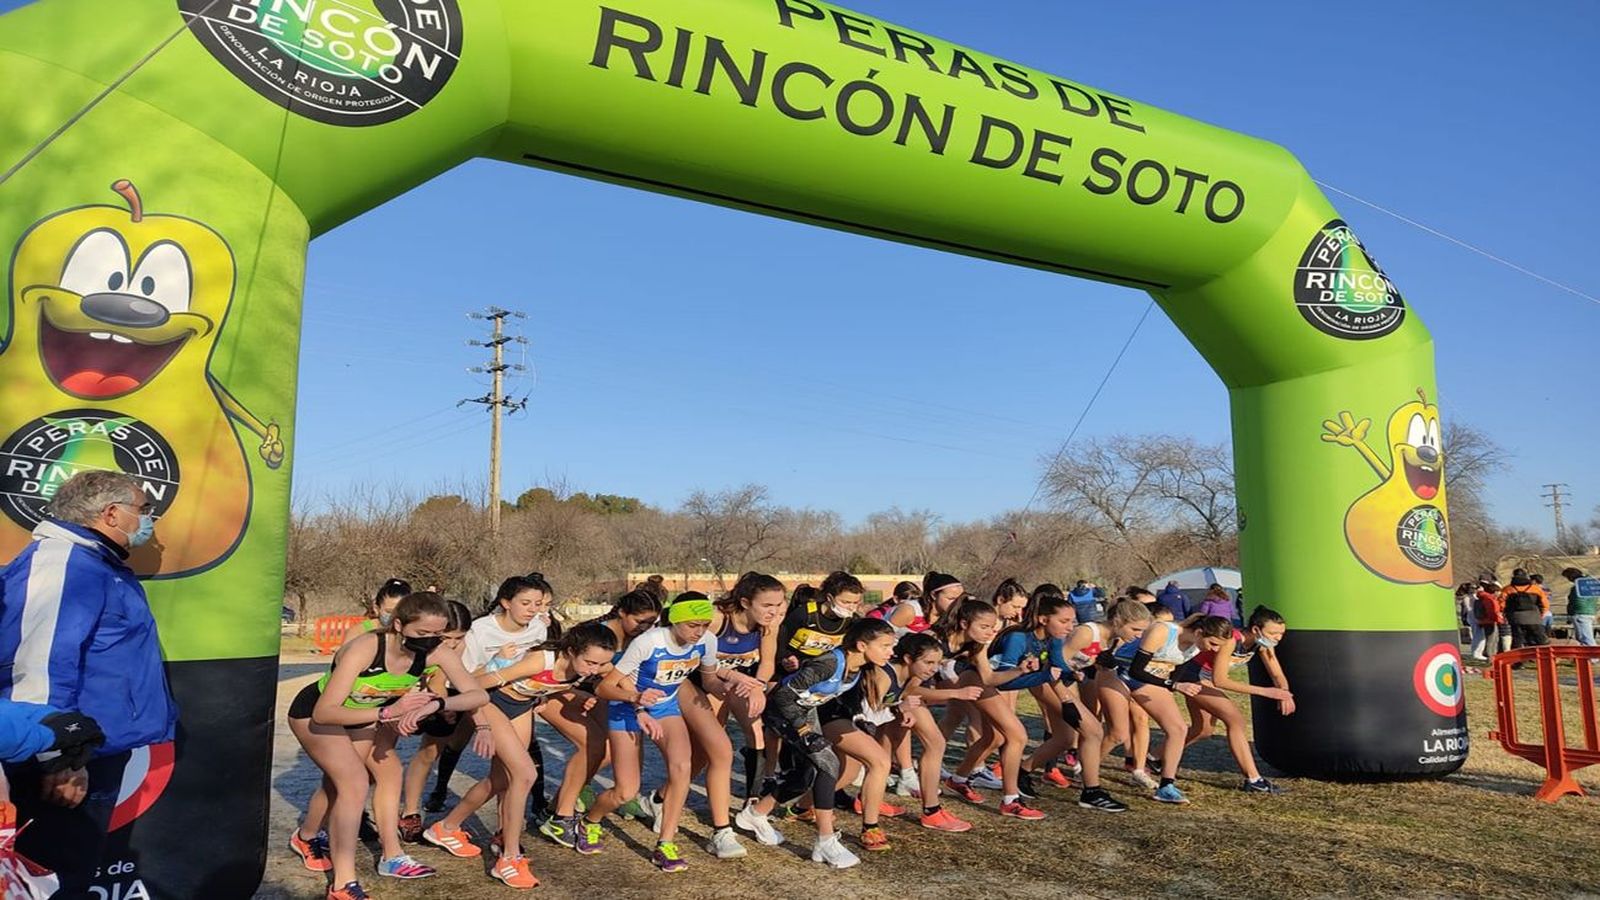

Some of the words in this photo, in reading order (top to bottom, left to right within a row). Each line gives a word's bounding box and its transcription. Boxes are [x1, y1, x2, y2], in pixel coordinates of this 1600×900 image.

[237, 0, 442, 81] NCÓN
[411, 0, 441, 30] E
[220, 25, 285, 85] DENOMINACIÓN
[286, 82, 301, 94] DE
[303, 90, 343, 107] ORIGEN
[344, 95, 396, 107] PROTEGIDA
[228, 4, 288, 35] DE
[302, 29, 404, 84] SOTO
[775, 0, 1038, 101] PERAS
[1049, 78, 1147, 134] DE
[257, 47, 283, 70] LA
[294, 70, 362, 98] RIOJA
[591, 7, 957, 156] RINCÓN
[968, 114, 1073, 186] DE
[1082, 147, 1246, 224] SOTO
[1319, 290, 1347, 303] DE
[1353, 291, 1395, 305] SOTO
[1335, 311, 1349, 322] LA
[1354, 313, 1387, 325] RIOJA
[27, 421, 131, 453] PERAS
[135, 442, 165, 473] DE
[21, 480, 59, 497] DE
[1423, 739, 1445, 752] LA
[107, 860, 136, 875] de
